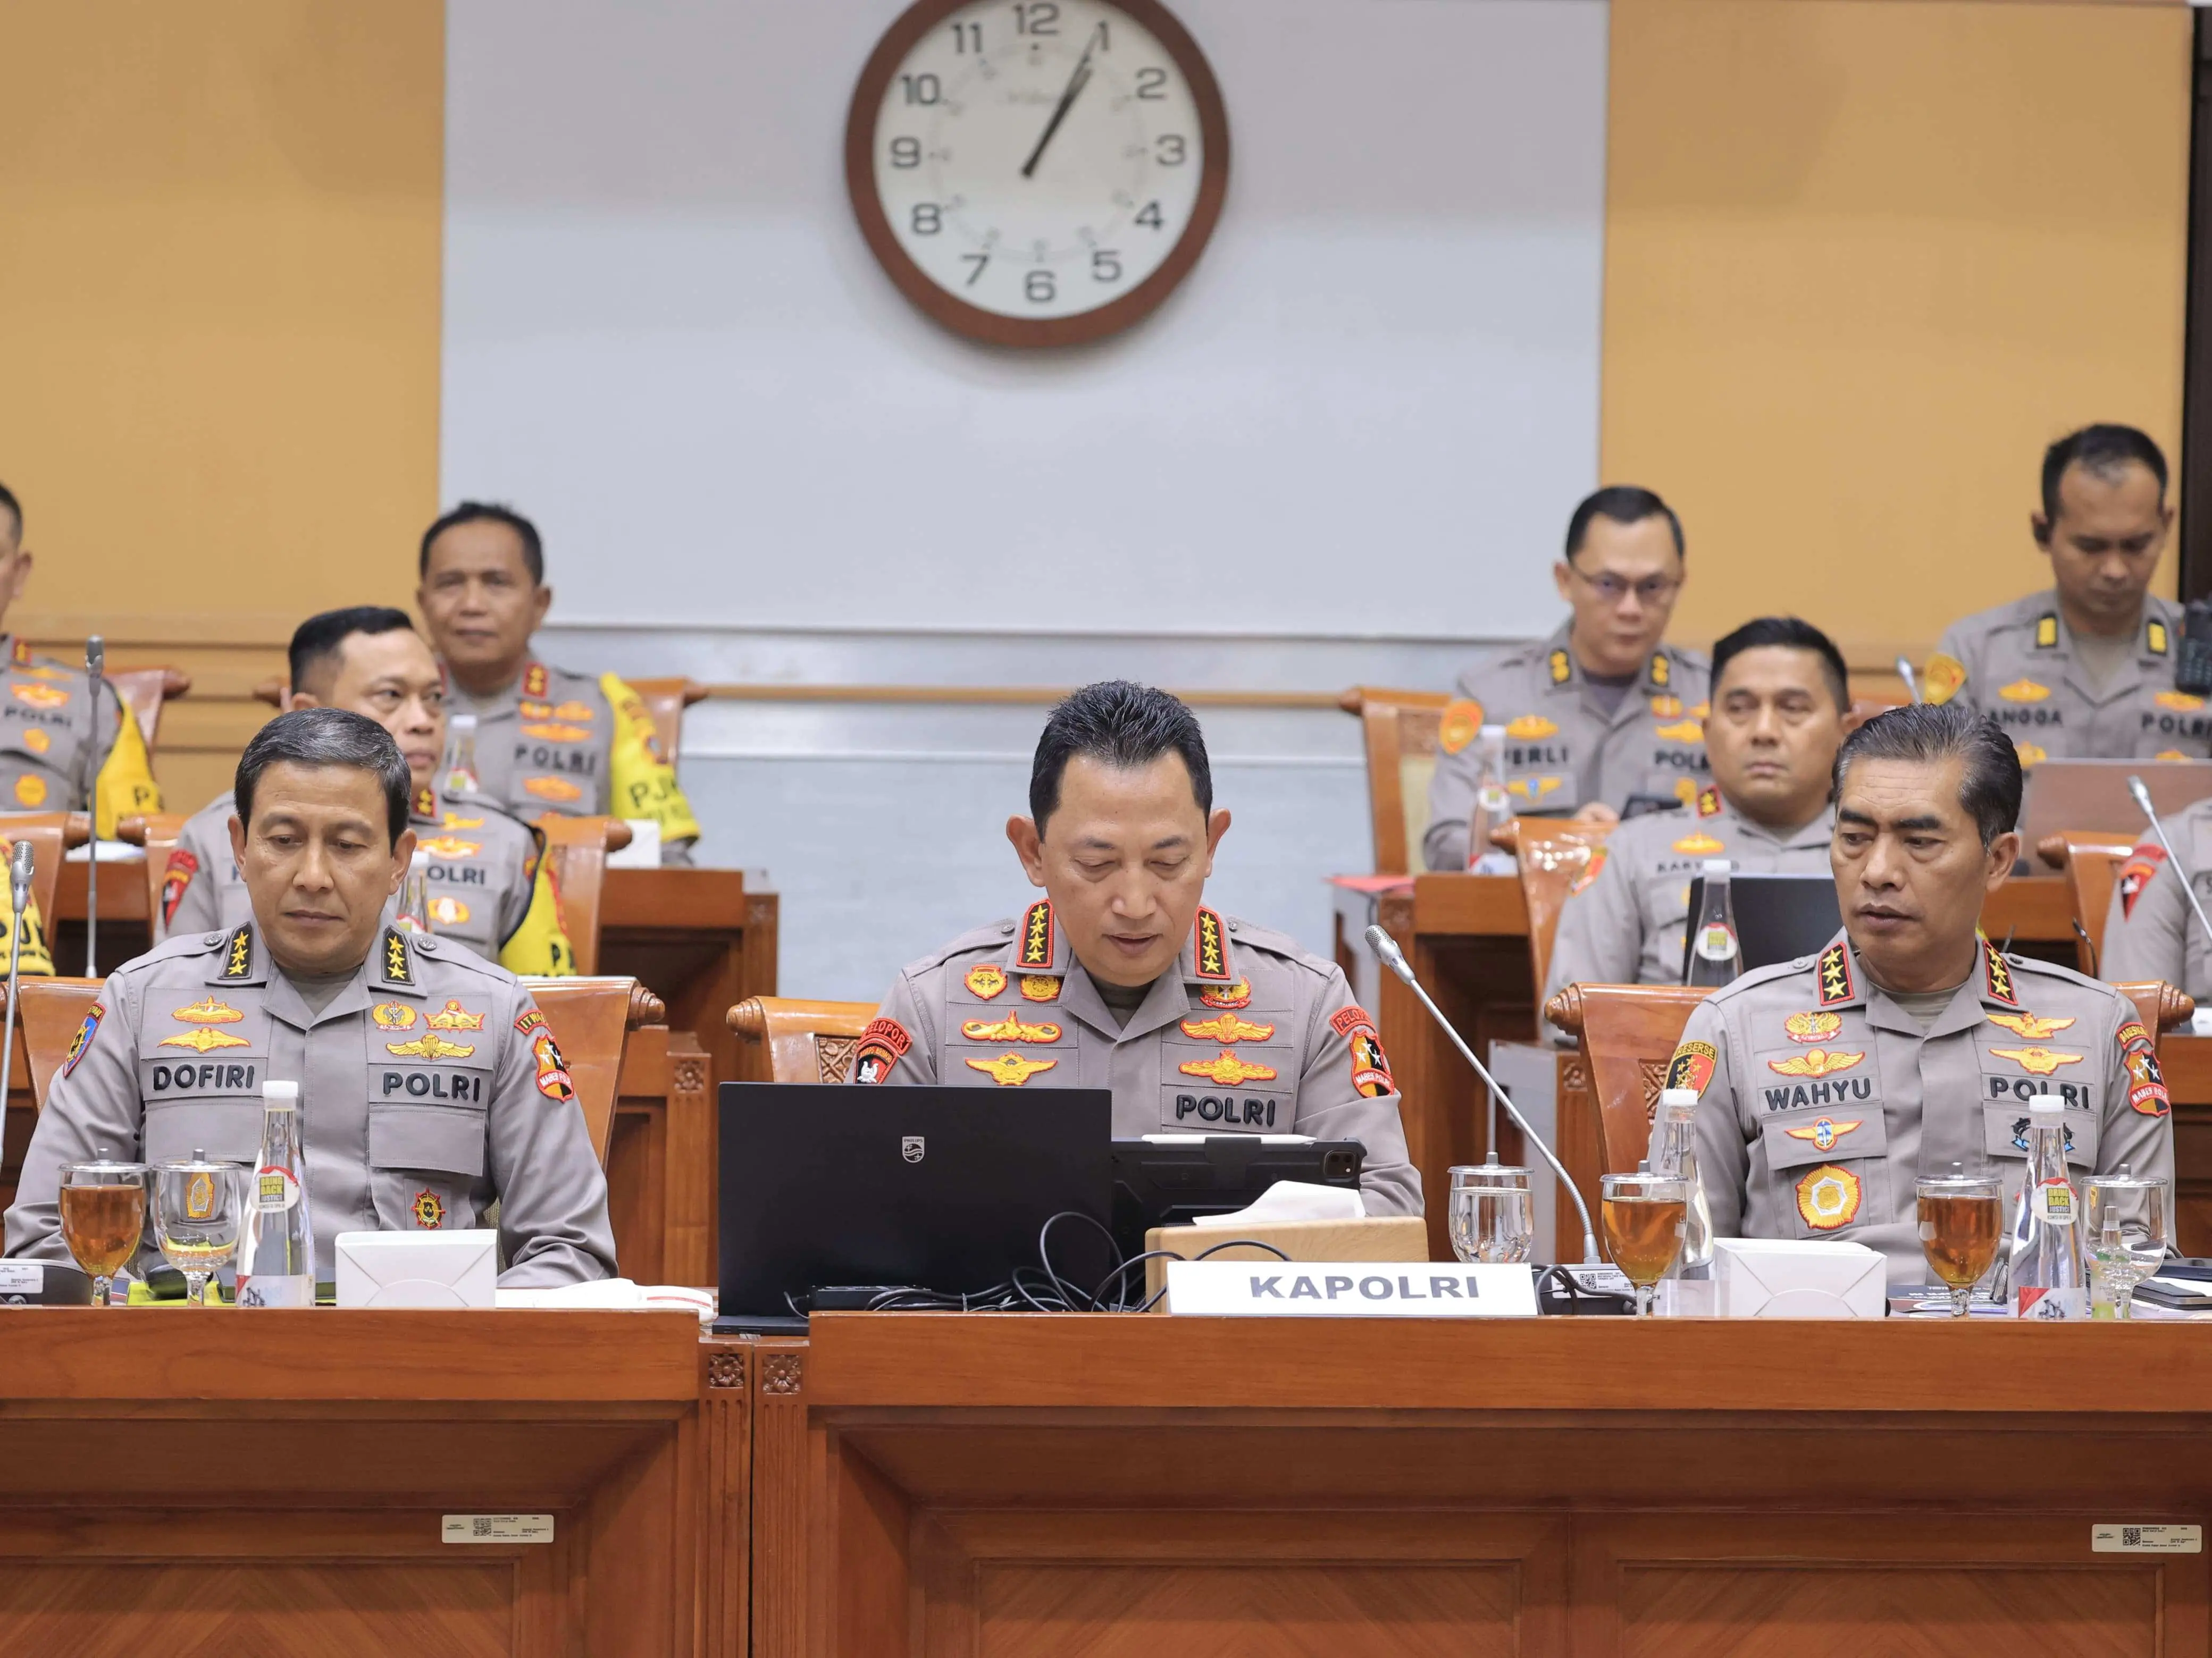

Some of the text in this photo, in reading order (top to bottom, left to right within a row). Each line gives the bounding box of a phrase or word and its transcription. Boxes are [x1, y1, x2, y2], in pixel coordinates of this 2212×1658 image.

[1013, 3, 1060, 35] 12
[953, 22, 982, 53] 11
[1099, 20, 1109, 52] 1
[902, 73, 940, 105] 10
[1135, 68, 1168, 99] 2
[890, 137, 920, 169] 9
[1155, 134, 1186, 166] 3
[911, 204, 942, 235] 8
[1134, 200, 1163, 230] 4
[961, 254, 990, 287] 7
[1092, 250, 1121, 282] 5
[1024, 270, 1055, 302] 6
[515, 744, 596, 776] POLRI
[427, 866, 485, 885] OLRI
[1675, 1042, 1715, 1058] RESERSE
[153, 1064, 255, 1090] DOFIRI
[383, 1072, 480, 1101] POLRI
[1355, 1072, 1375, 1083] MABES
[1765, 1078, 1872, 1111] WAHYU
[1176, 1094, 1276, 1127] POLRI
[261, 1185, 283, 1196] BACK
[2048, 1196, 2069, 1206] BACK
[1250, 1276, 1479, 1299] KAPOLRI
